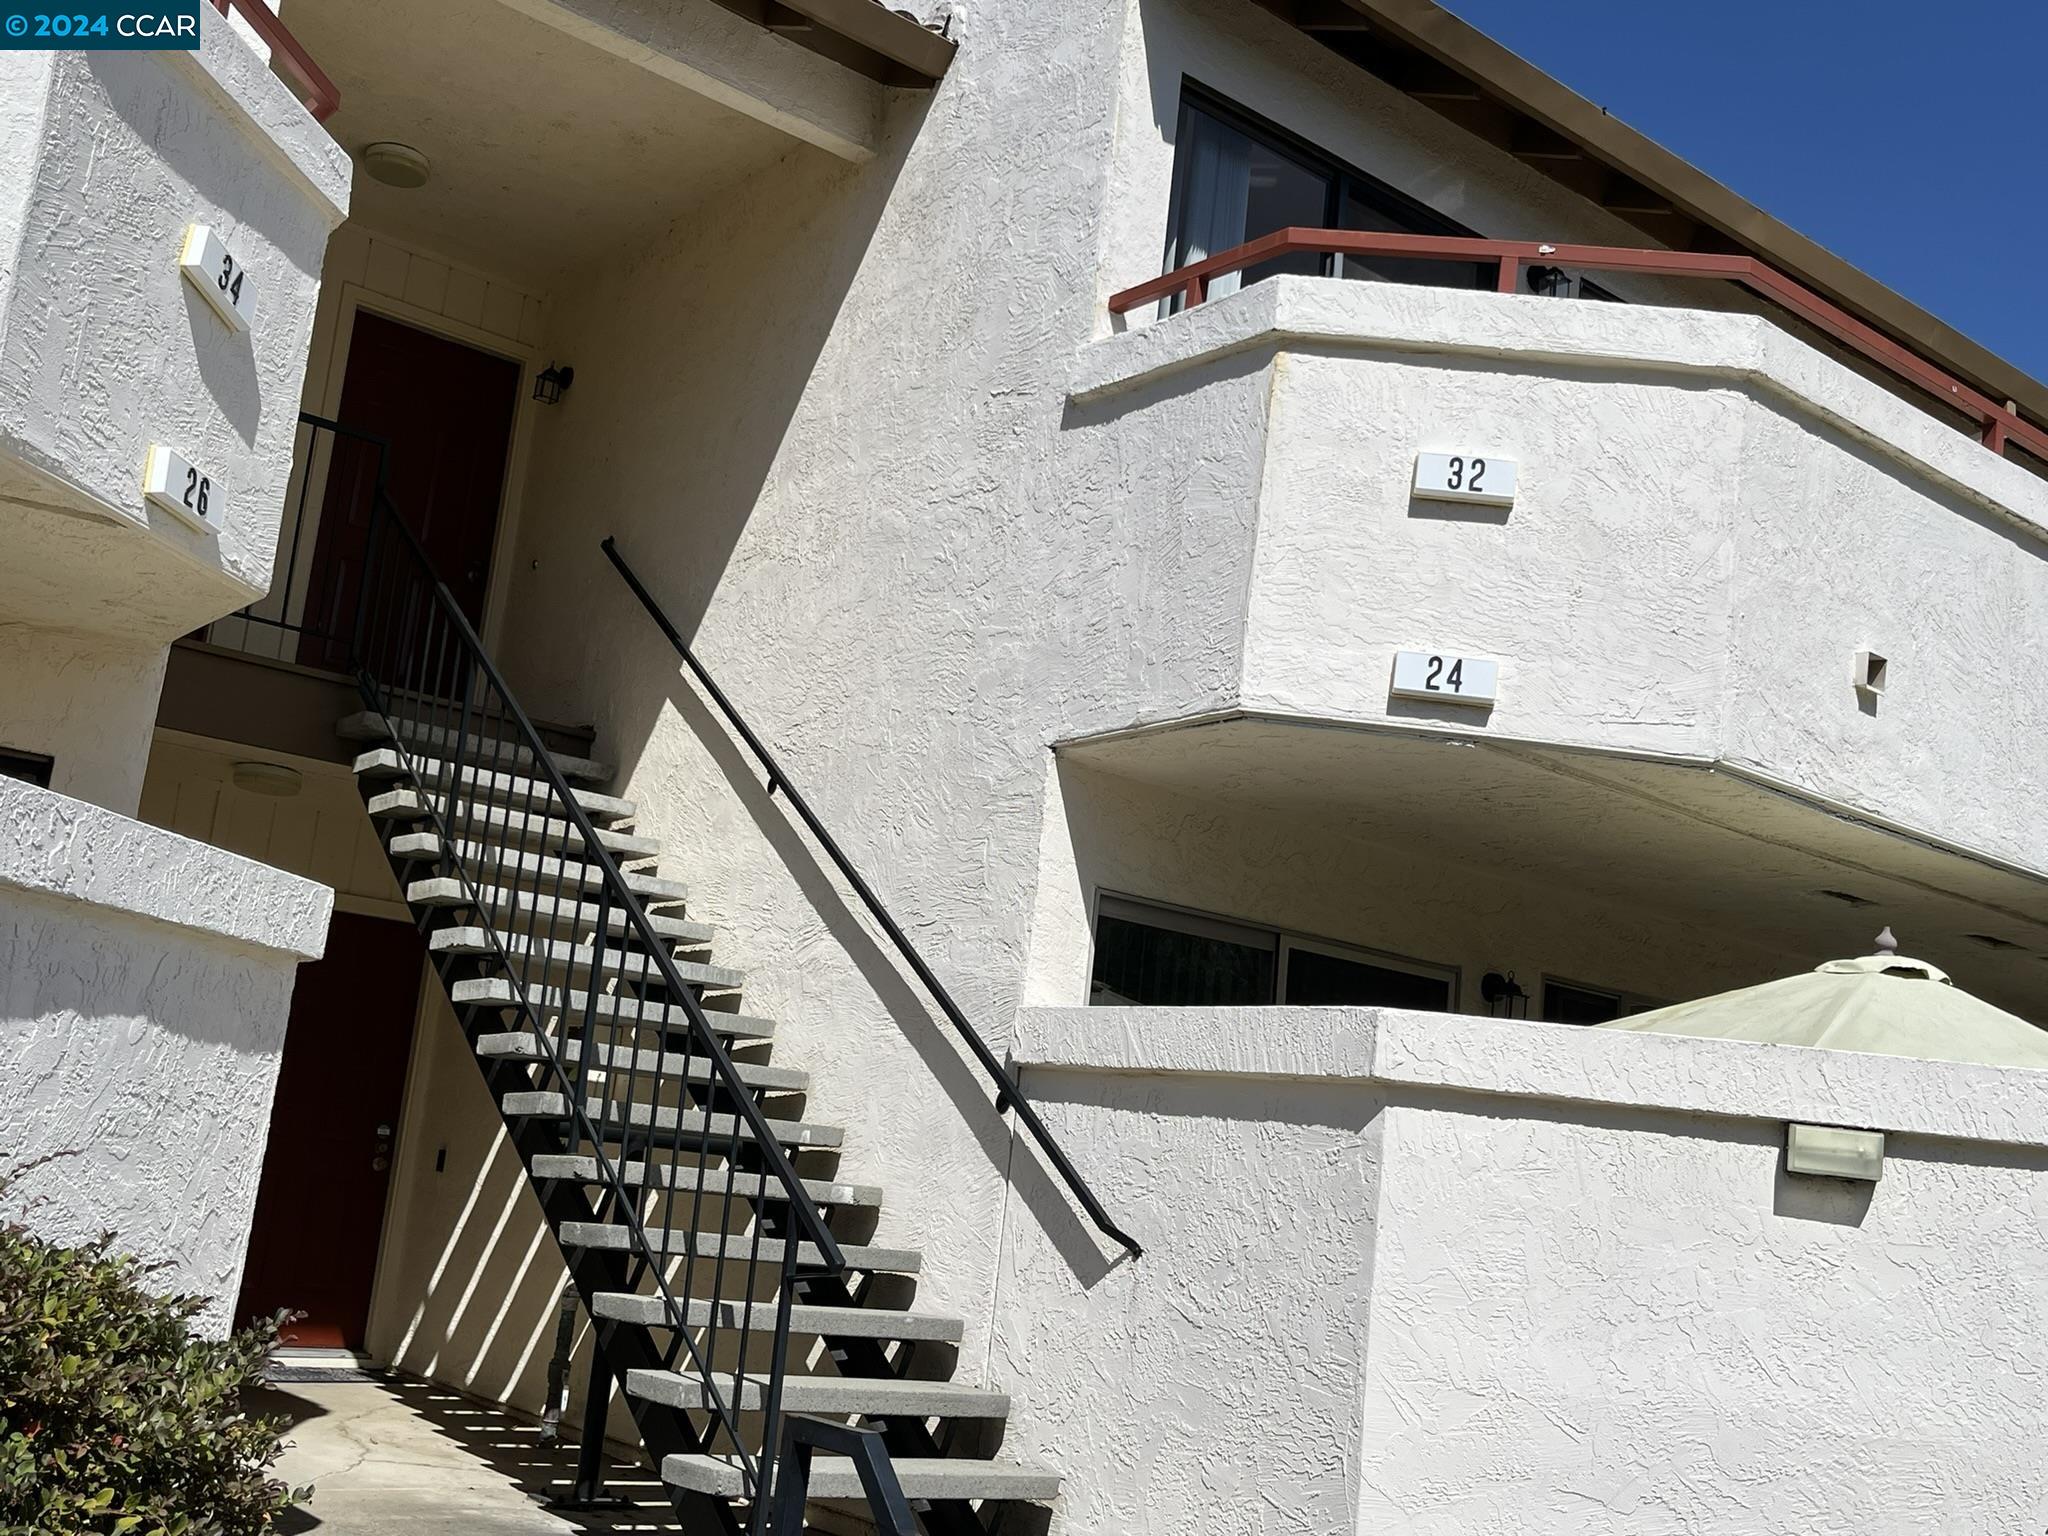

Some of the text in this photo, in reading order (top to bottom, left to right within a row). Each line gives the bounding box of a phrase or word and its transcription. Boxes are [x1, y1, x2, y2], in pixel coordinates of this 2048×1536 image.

[218, 254, 244, 306] 34
[183, 467, 211, 516] 26
[1447, 456, 1486, 493] 32
[1425, 655, 1463, 693] 24
